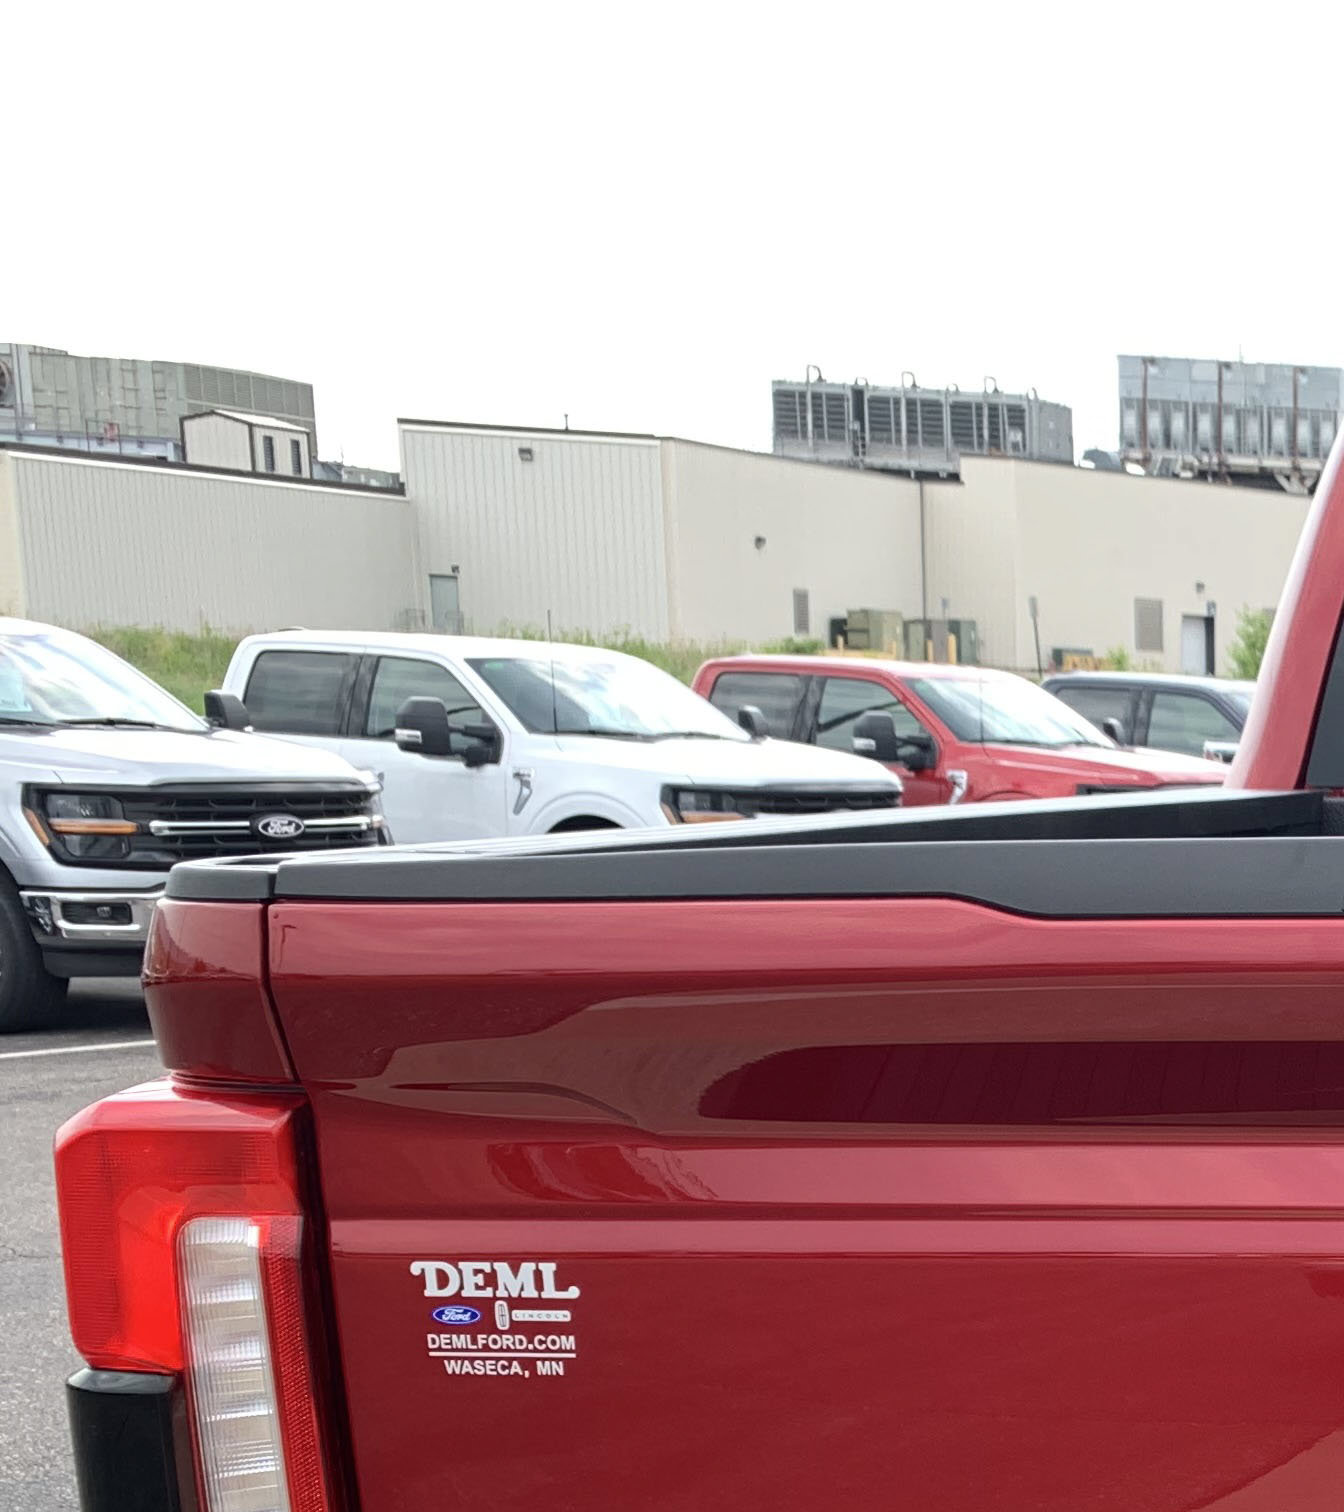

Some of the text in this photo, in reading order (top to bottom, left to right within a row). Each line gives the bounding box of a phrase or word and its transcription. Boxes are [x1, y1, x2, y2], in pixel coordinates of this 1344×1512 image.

[410, 1261, 580, 1299] DEML
[427, 1334, 576, 1350] DEMLFORD.COM
[444, 1360, 565, 1378] WASECA, MN
